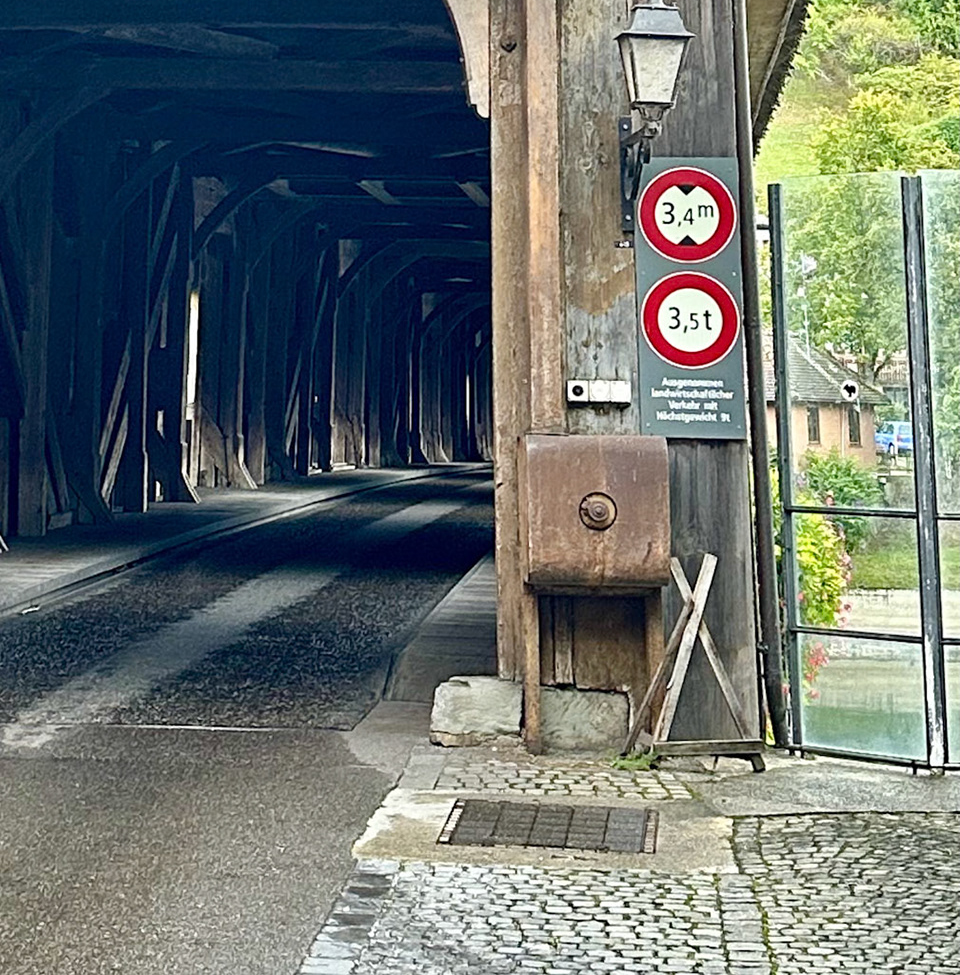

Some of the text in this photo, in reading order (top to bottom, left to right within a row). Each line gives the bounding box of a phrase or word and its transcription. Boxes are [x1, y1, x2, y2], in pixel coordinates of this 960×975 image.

[661, 377, 724, 389] Ausgenommen
[651, 387, 734, 400] landwirtschaftlicher
[668, 400, 718, 410] Verkehr mit
[656, 411, 717, 423] Höchstgewicht
